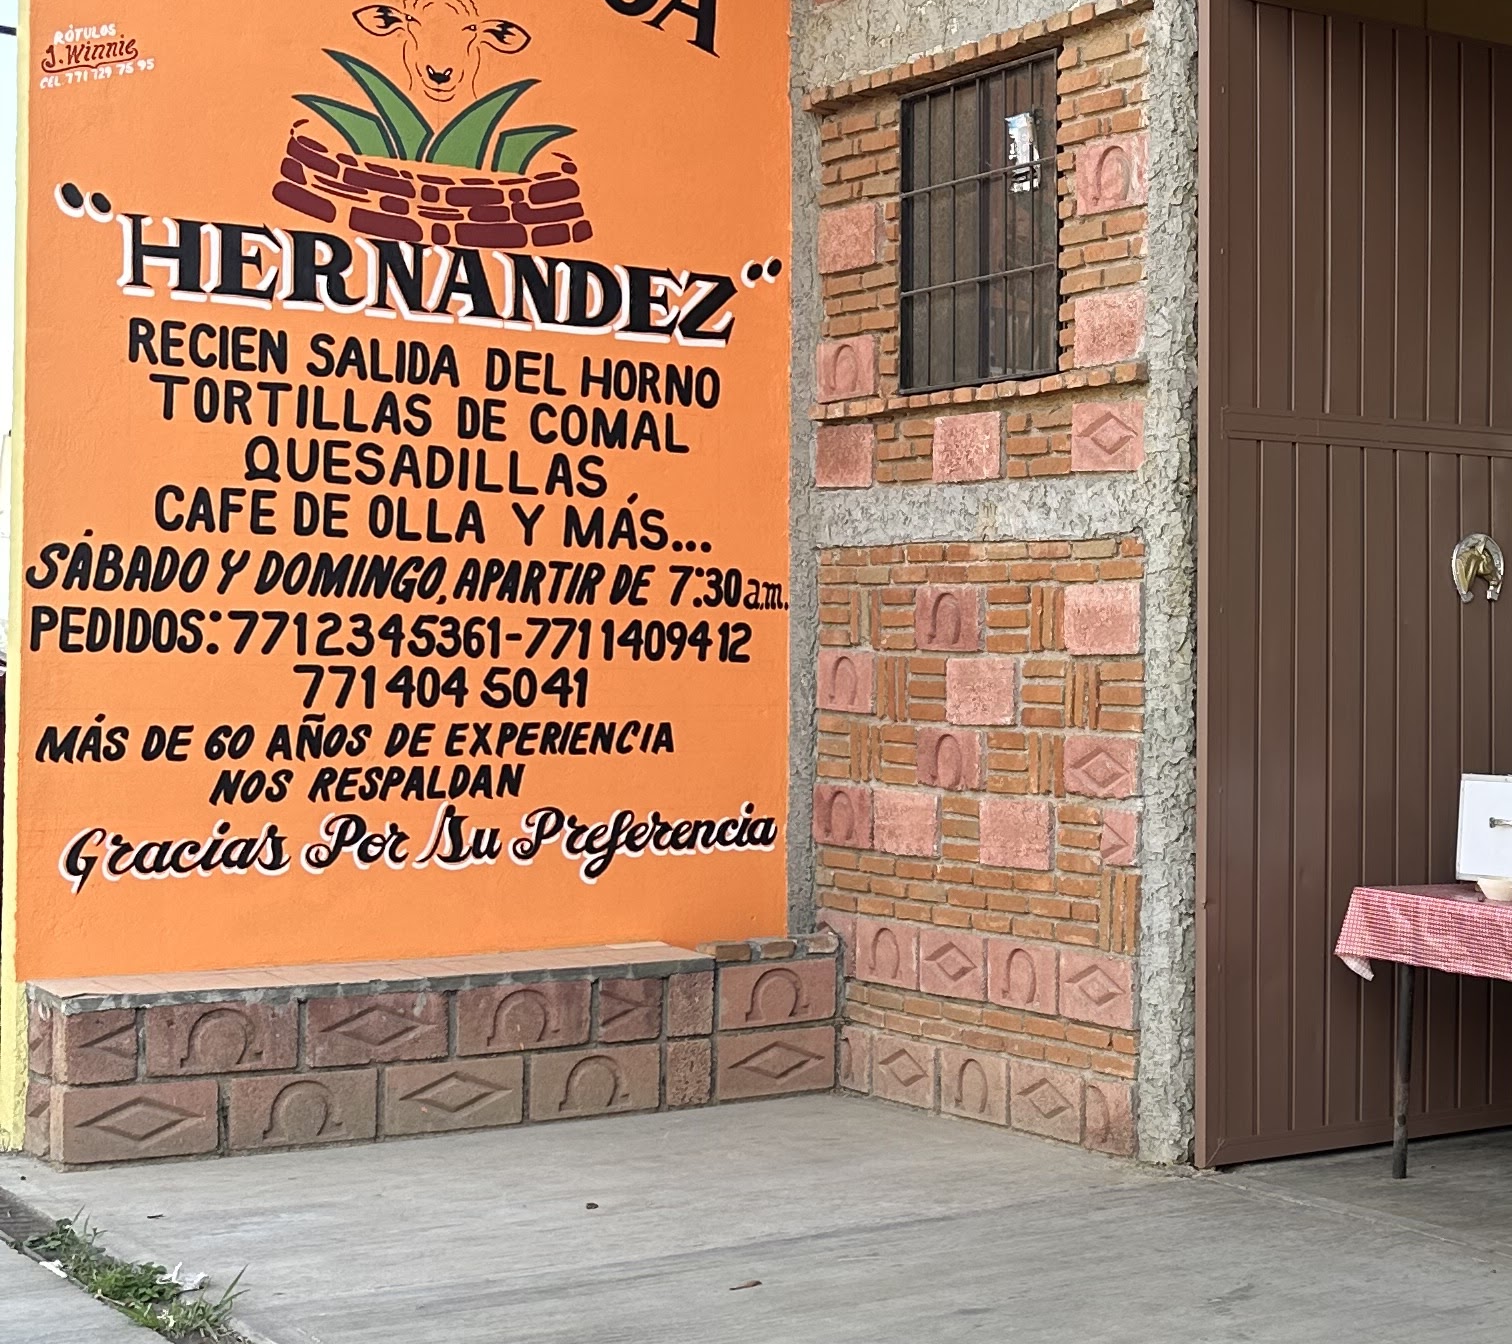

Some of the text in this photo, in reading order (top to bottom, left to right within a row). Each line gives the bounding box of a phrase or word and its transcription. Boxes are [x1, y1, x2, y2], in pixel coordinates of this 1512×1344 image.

[53, 23, 117, 46] RÓTULOS
[65, 72, 89, 85] 771
[91, 66, 112, 80] 729
[116, 62, 134, 76] 75
[137, 58, 155, 71] 95
[128, 317, 720, 409] RECIEN SALIDA DEL HORNO
[149, 373, 690, 454] TORTILLAS DE COMAL
[244, 435, 608, 498] QUESADILLAS
[154, 484, 712, 553] CAFE DE OLLA Y MÁS...
[25, 529, 210, 593] SÁBADO
[216, 548, 251, 595] Y
[254, 550, 447, 606] DOMINGO,
[609, 564, 656, 606] DE
[35, 713, 674, 764] MÁS DE 60 AÑOS DE EXPERIENCIA
[209, 763, 526, 806] NOS RESPALDAN
[62, 802, 778, 895] Gracias Por Su Preferencia
